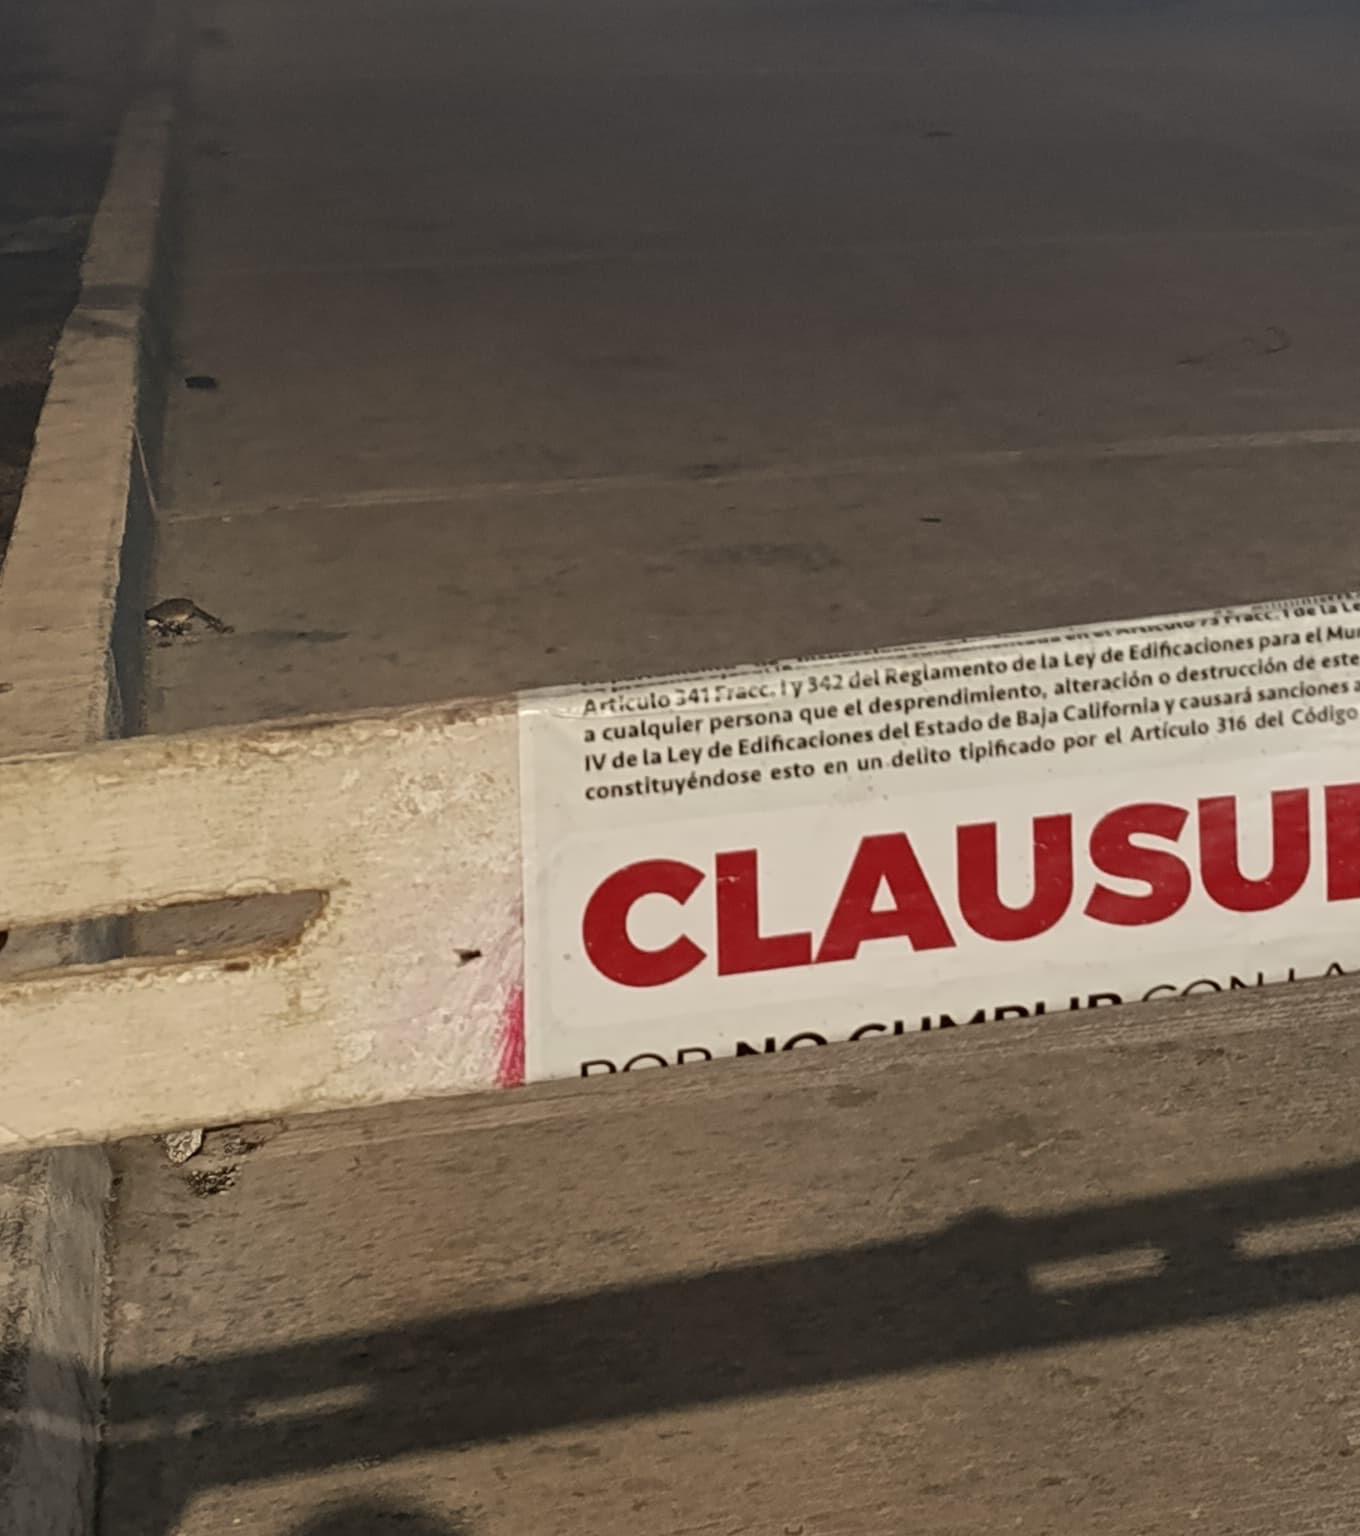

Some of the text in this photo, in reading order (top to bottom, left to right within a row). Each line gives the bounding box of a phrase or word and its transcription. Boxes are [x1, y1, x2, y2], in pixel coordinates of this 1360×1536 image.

[583, 728, 596, 744] a
[602, 715, 703, 742] cualquier
[709, 708, 793, 736] persona
[799, 704, 838, 726] que
[844, 698, 863, 718] el
[868, 683, 1048, 716] desprendimiento,
[1053, 669, 1153, 696] alteración
[1158, 671, 1171, 687] o
[1176, 656, 1288, 684] destrucción
[1292, 653, 1316, 673] de
[1320, 652, 1360, 670] este
[791, 680, 803, 700] y
[807, 673, 843, 695] 342
[848, 668, 881, 691] del
[885, 659, 1008, 689] Reglamento
[1012, 655, 1038, 674] de
[1040, 652, 1059, 671] la
[1064, 651, 1096, 670] Ley
[1100, 646, 1124, 665] de
[1129, 636, 1254, 662] Edificaciones
[1259, 631, 1301, 654] para
[1305, 626, 1323, 645] el
[584, 768, 762, 802] constituyéndose
[770, 762, 815, 782] esto
[823, 760, 849, 776] en
[857, 756, 883, 773] un
[891, 745, 952, 769] delito
[959, 735, 1055, 764] tipificado
[1063, 733, 1097, 755] por
[1104, 726, 1123, 746] el
[1130, 718, 1210, 743] Artículo
[1216, 714, 1247, 734] 316
[1255, 709, 1285, 730] del
[1291, 704, 1359, 727] Código
[585, 752, 607, 773] IV
[611, 750, 638, 770] de
[642, 747, 662, 767] la
[667, 746, 703, 766] Ley
[707, 740, 733, 760] de
[738, 729, 874, 757] Edificaciones
[878, 721, 911, 742] del
[915, 715, 984, 738] Estado
[987, 711, 1012, 731] de
[1016, 706, 1059, 729] Baja
[1063, 696, 1161, 723] California
[1164, 698, 1176, 717] y
[1179, 685, 1253, 711] causará
[1256, 680, 1349, 703] sanciones
